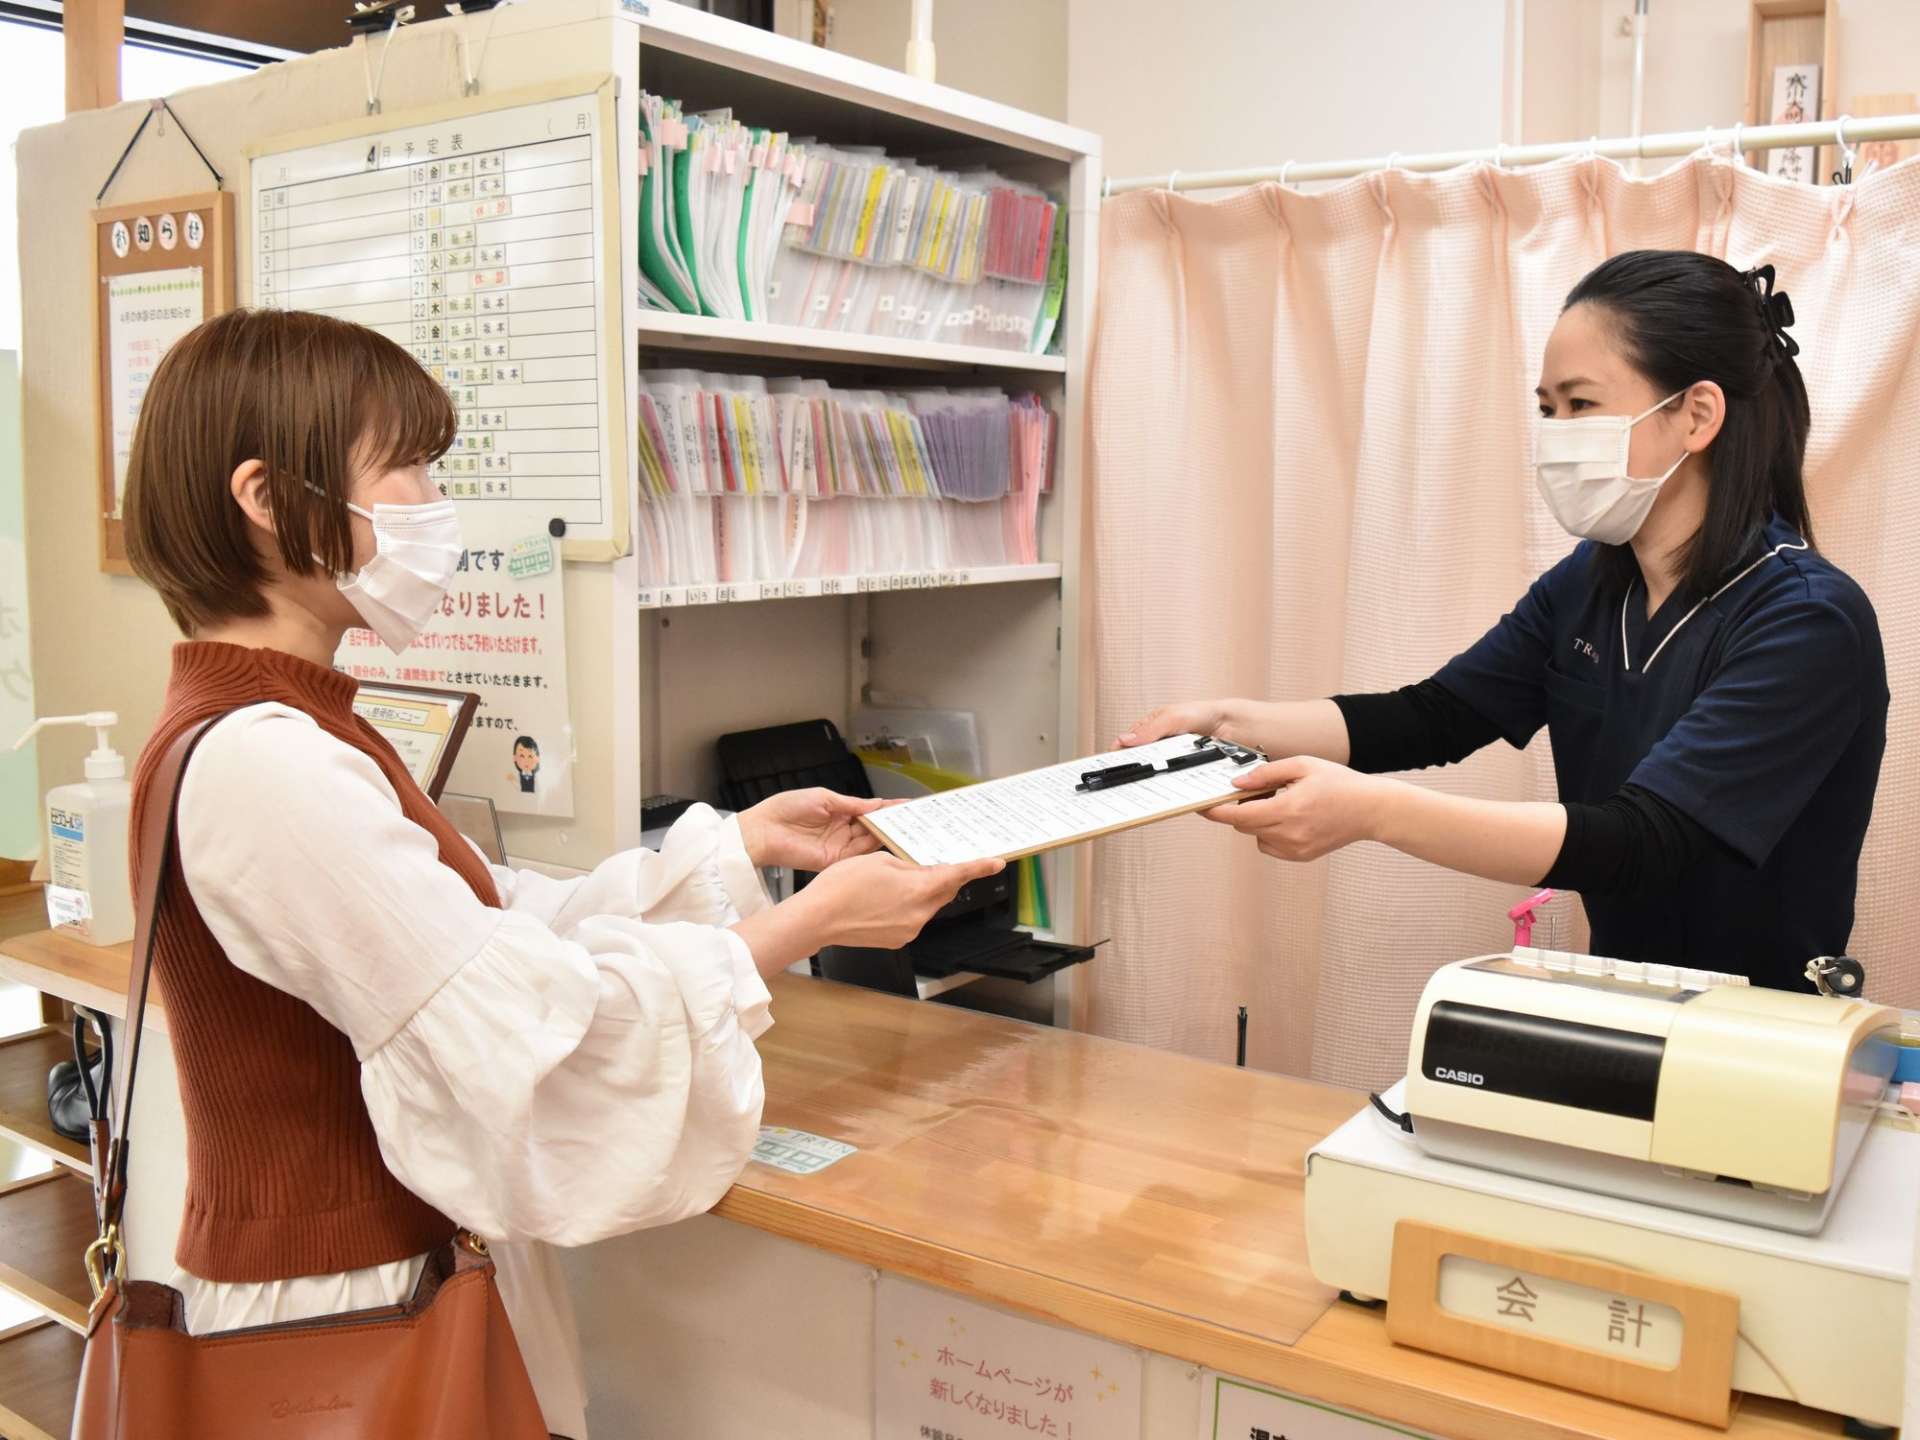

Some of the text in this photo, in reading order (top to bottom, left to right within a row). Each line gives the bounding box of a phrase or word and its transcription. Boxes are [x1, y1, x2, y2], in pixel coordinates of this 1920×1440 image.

[115, 219, 200, 249] お知らせ
[433, 591, 545, 620] なりました！
[1435, 1066, 1484, 1086] CASIO
[1496, 1276, 1653, 1348] 会計
[937, 1345, 1074, 1404] ホームページが
[928, 1377, 1074, 1440] 新しくなりました！
